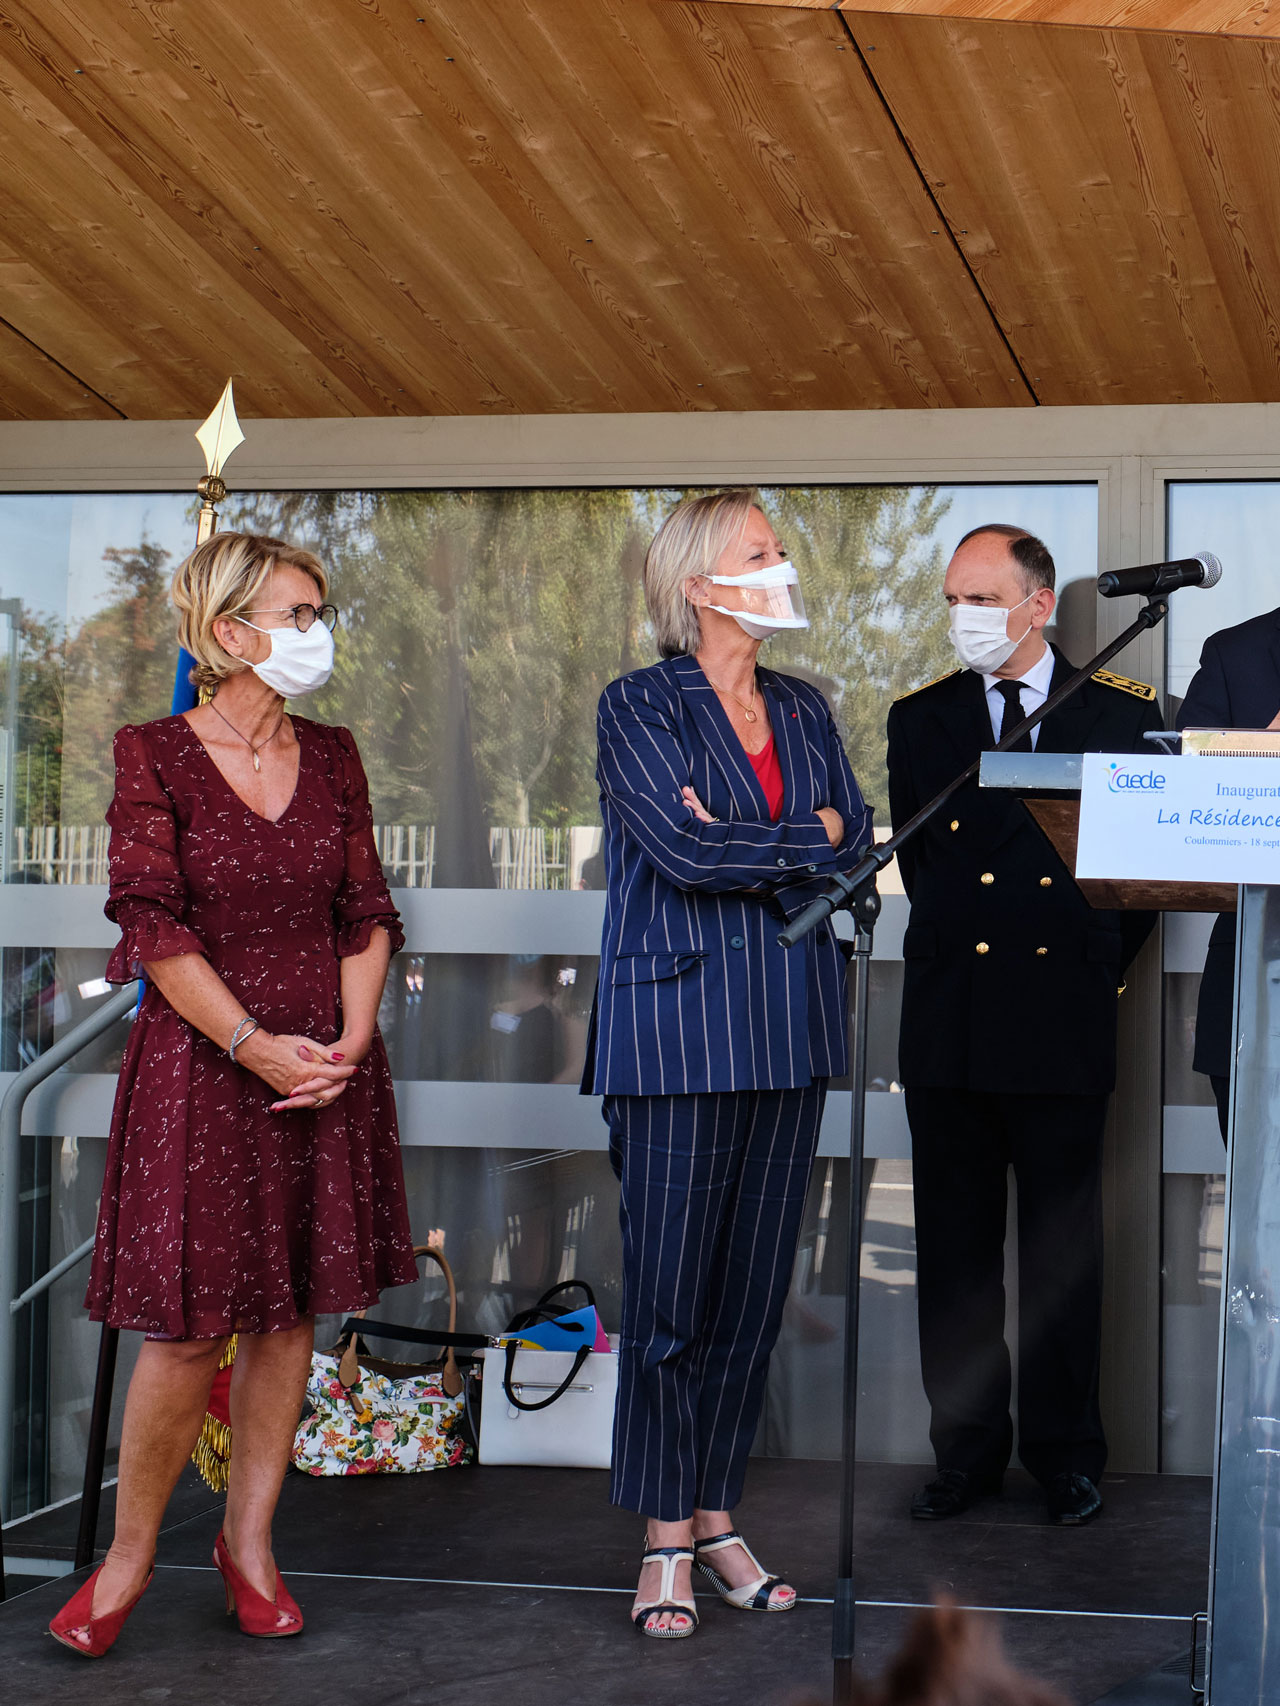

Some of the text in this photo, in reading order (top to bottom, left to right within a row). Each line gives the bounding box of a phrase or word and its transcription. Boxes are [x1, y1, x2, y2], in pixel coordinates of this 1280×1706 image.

[1116, 770, 1166, 789] aede
[1157, 808, 1181, 825] La
[1184, 835, 1242, 846] Coulommiers
[1250, 837, 1261, 847] 18
